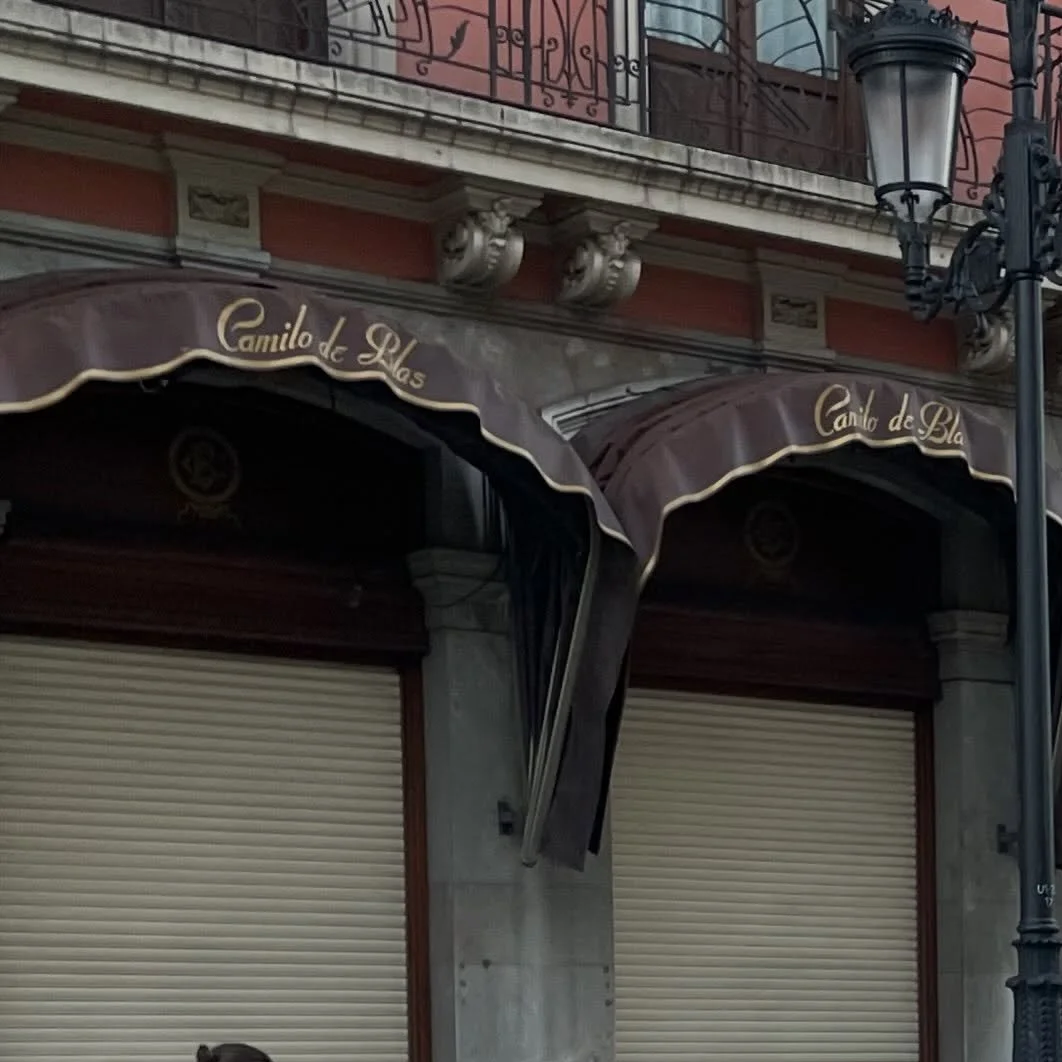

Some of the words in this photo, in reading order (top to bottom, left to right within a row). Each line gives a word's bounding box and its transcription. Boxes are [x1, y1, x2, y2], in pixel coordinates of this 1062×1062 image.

[216, 298, 313, 352] Camilo
[319, 316, 348, 363] de
[357, 322, 427, 389] Blas
[888, 393, 915, 432] de
[918, 401, 965, 446] Bla
